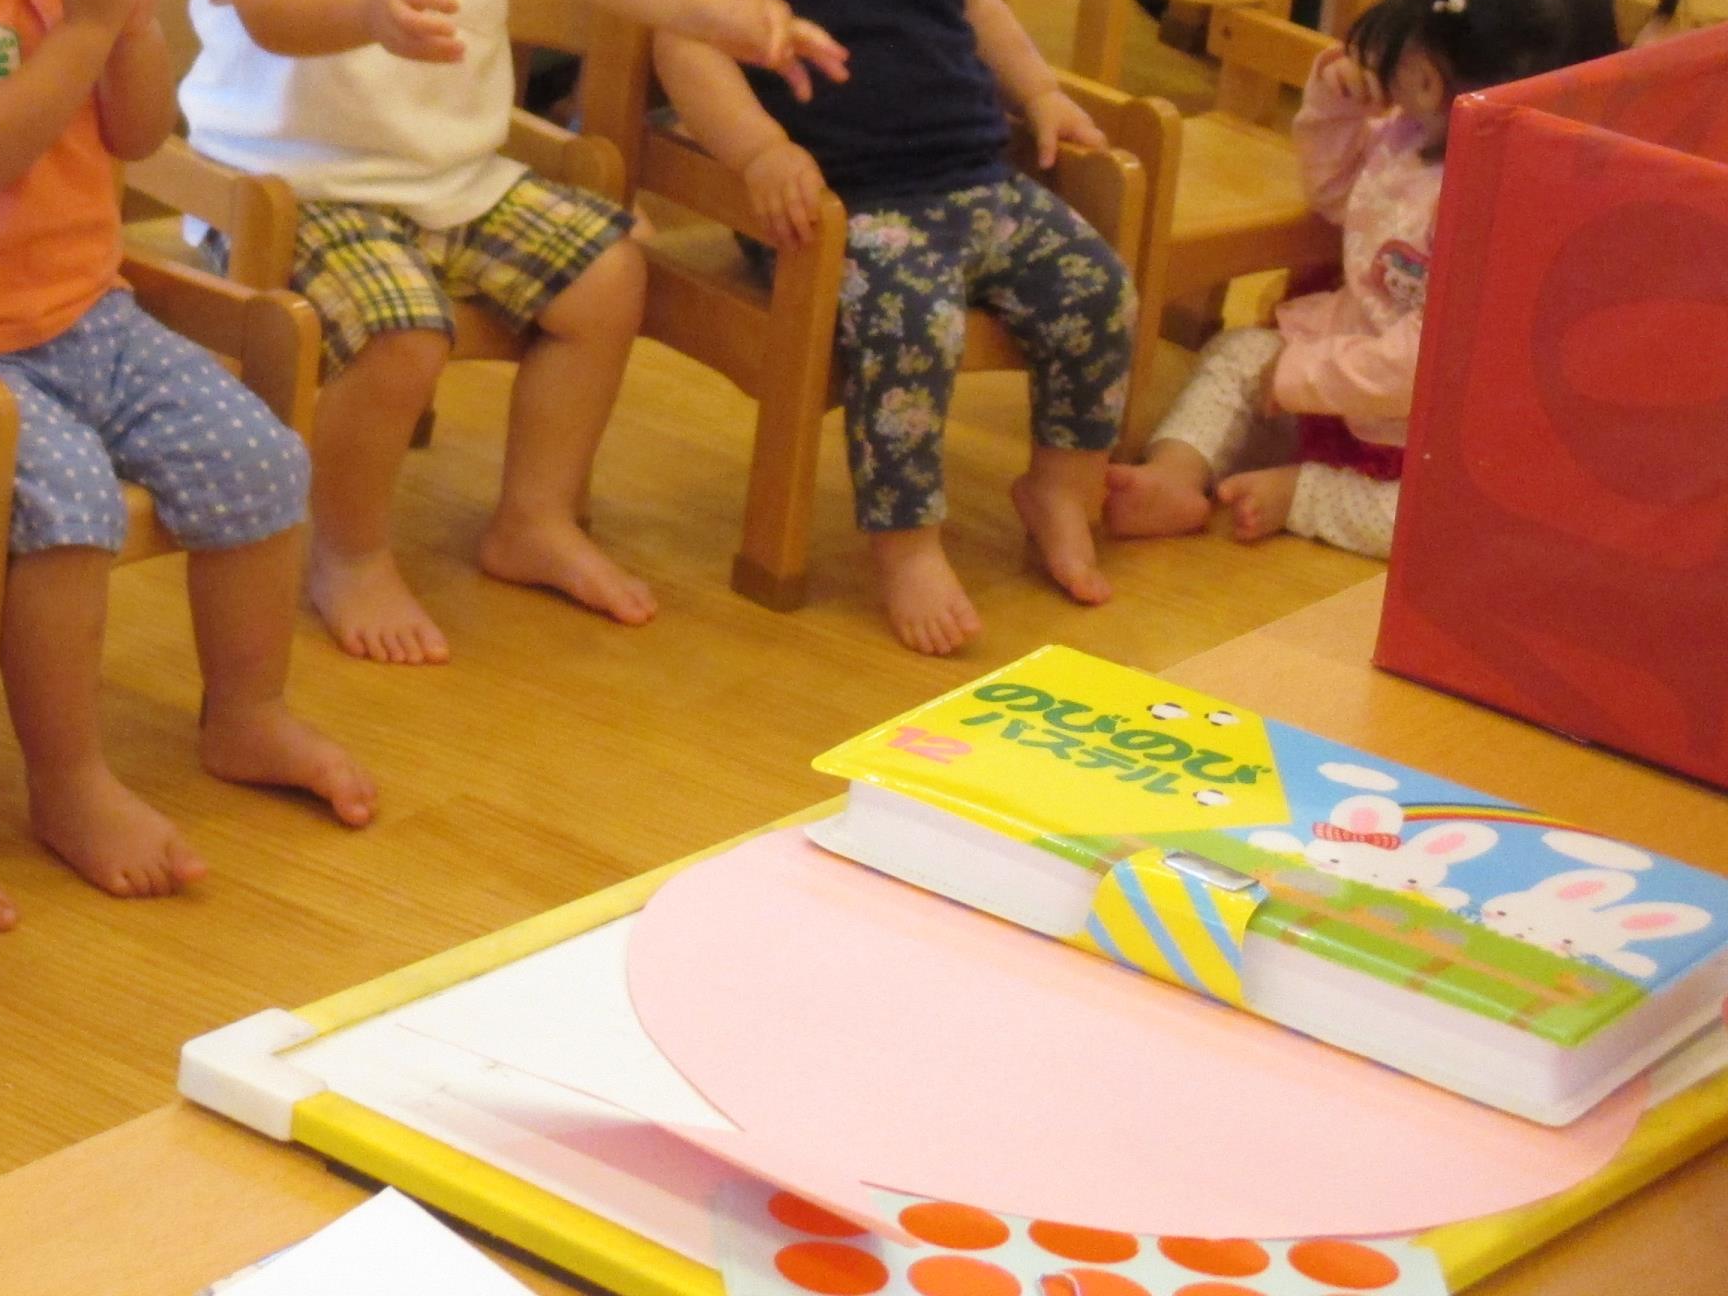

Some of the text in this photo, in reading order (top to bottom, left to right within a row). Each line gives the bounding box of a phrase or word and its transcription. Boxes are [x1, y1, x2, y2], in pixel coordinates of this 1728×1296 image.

[887, 726, 972, 765] 12
[960, 711, 1181, 795] パステル
[973, 683, 1271, 784] のびのび
